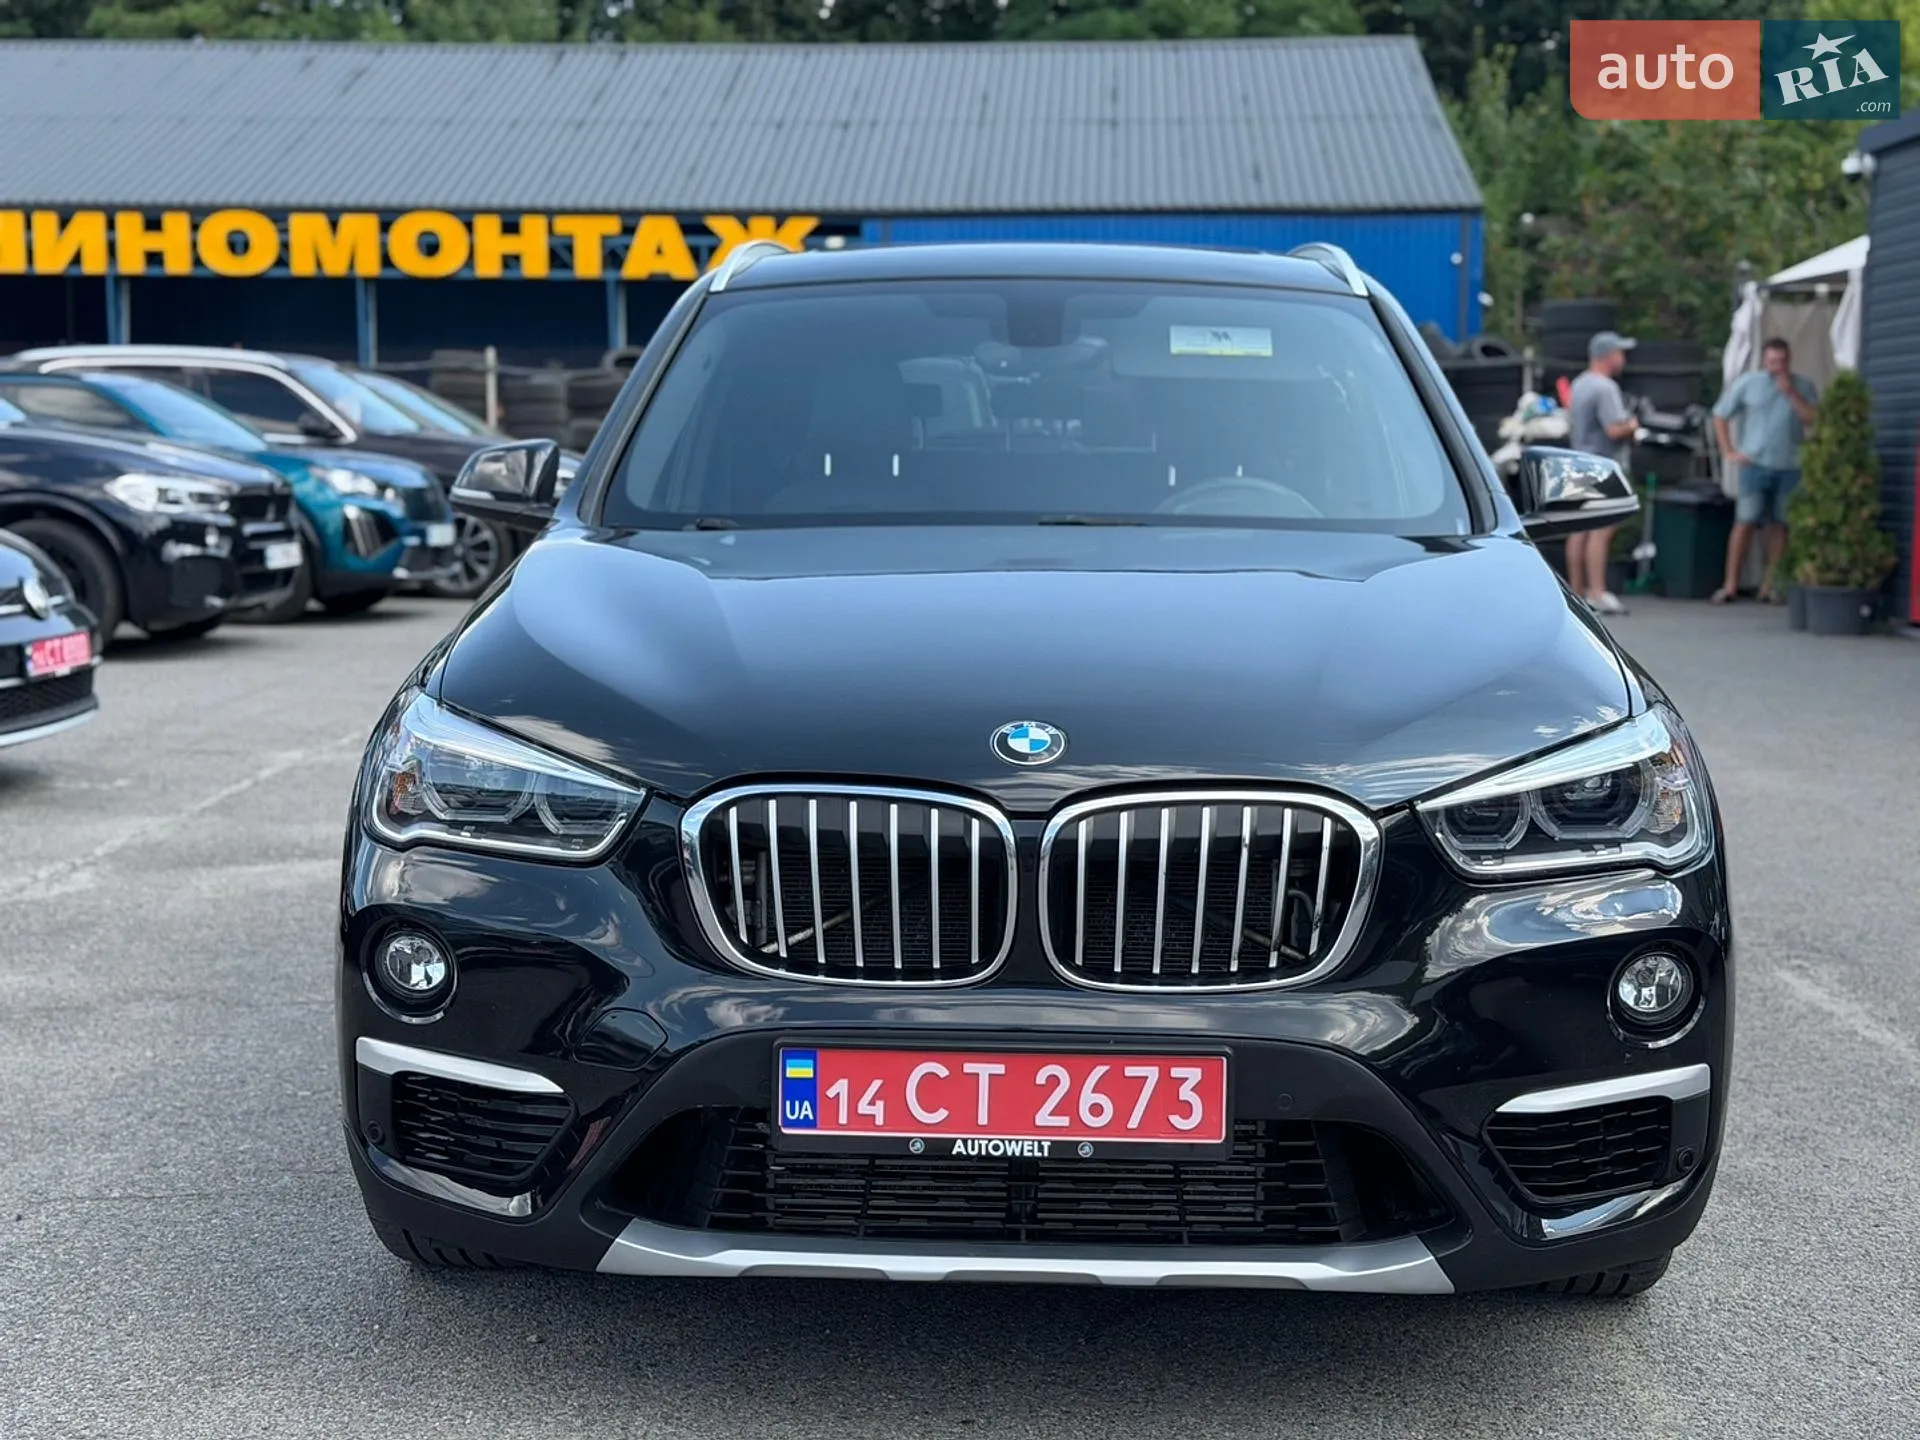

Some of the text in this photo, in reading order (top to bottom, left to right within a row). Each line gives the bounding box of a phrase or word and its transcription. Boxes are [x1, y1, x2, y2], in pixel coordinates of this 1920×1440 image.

[0, 209, 819, 279] ИНОМОНТАЖ
[786, 1100, 813, 1121] UA
[825, 1061, 1203, 1131] 14 CT 2673
[952, 1139, 1051, 1157] AUTOWELT
